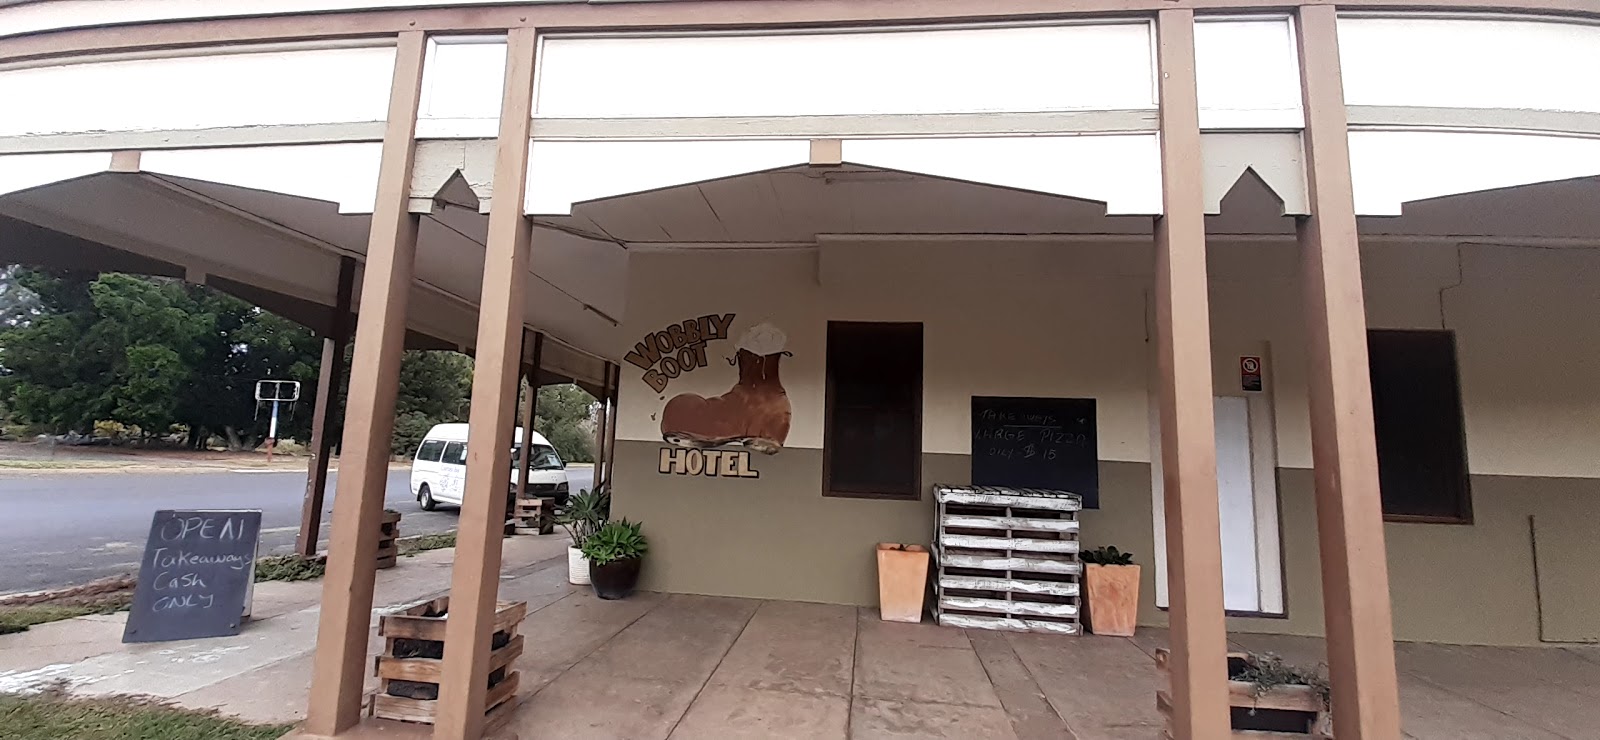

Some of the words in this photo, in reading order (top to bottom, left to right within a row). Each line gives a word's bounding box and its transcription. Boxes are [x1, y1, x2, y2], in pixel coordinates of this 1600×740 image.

[624, 313, 736, 370] WOBBLY
[642, 342, 708, 394] BOOT
[975, 429, 1026, 441] LARGE
[1040, 428, 1087, 447] PIZZA
[658, 447, 759, 479] HOTEL
[1043, 448, 1057, 460] 15
[161, 516, 244, 541] OPEN
